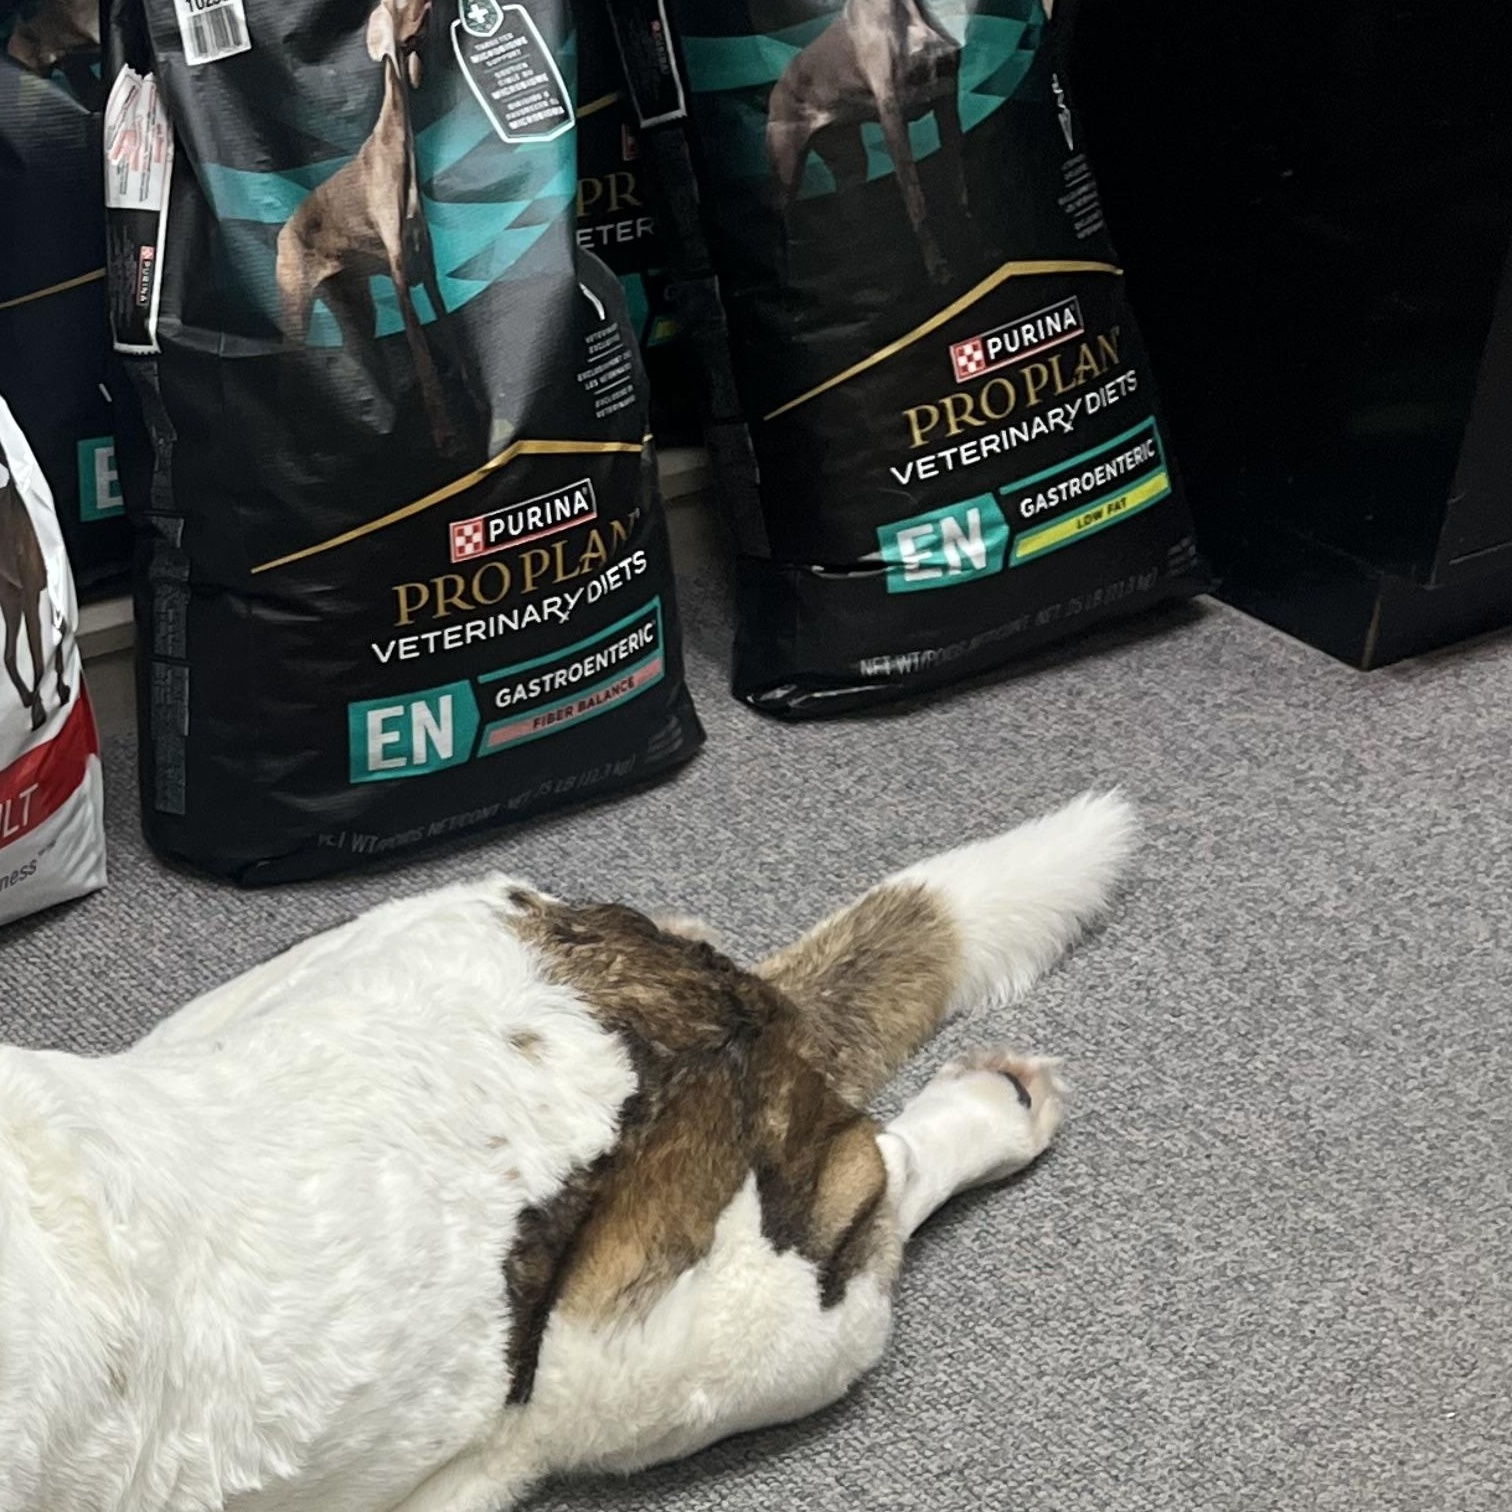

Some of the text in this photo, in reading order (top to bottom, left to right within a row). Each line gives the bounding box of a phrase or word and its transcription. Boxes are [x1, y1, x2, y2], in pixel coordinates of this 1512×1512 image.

[575, 171, 642, 218] PR
[986, 307, 1076, 360] PURINA
[890, 369, 1138, 485] VETERINARY DIETS
[902, 330, 1119, 449] PRO PLAN
[94, 446, 124, 510] E
[489, 487, 588, 543] PURINA
[896, 438, 1156, 581] EN GASTROENTERIC
[1076, 497, 1128, 530] LOW FAT
[372, 550, 648, 664] VETERINARY DIETS
[392, 514, 635, 627] PRO PLAN
[366, 622, 655, 772] EN GASTROENTERIC
[532, 676, 636, 730] FIBER BALANCE
